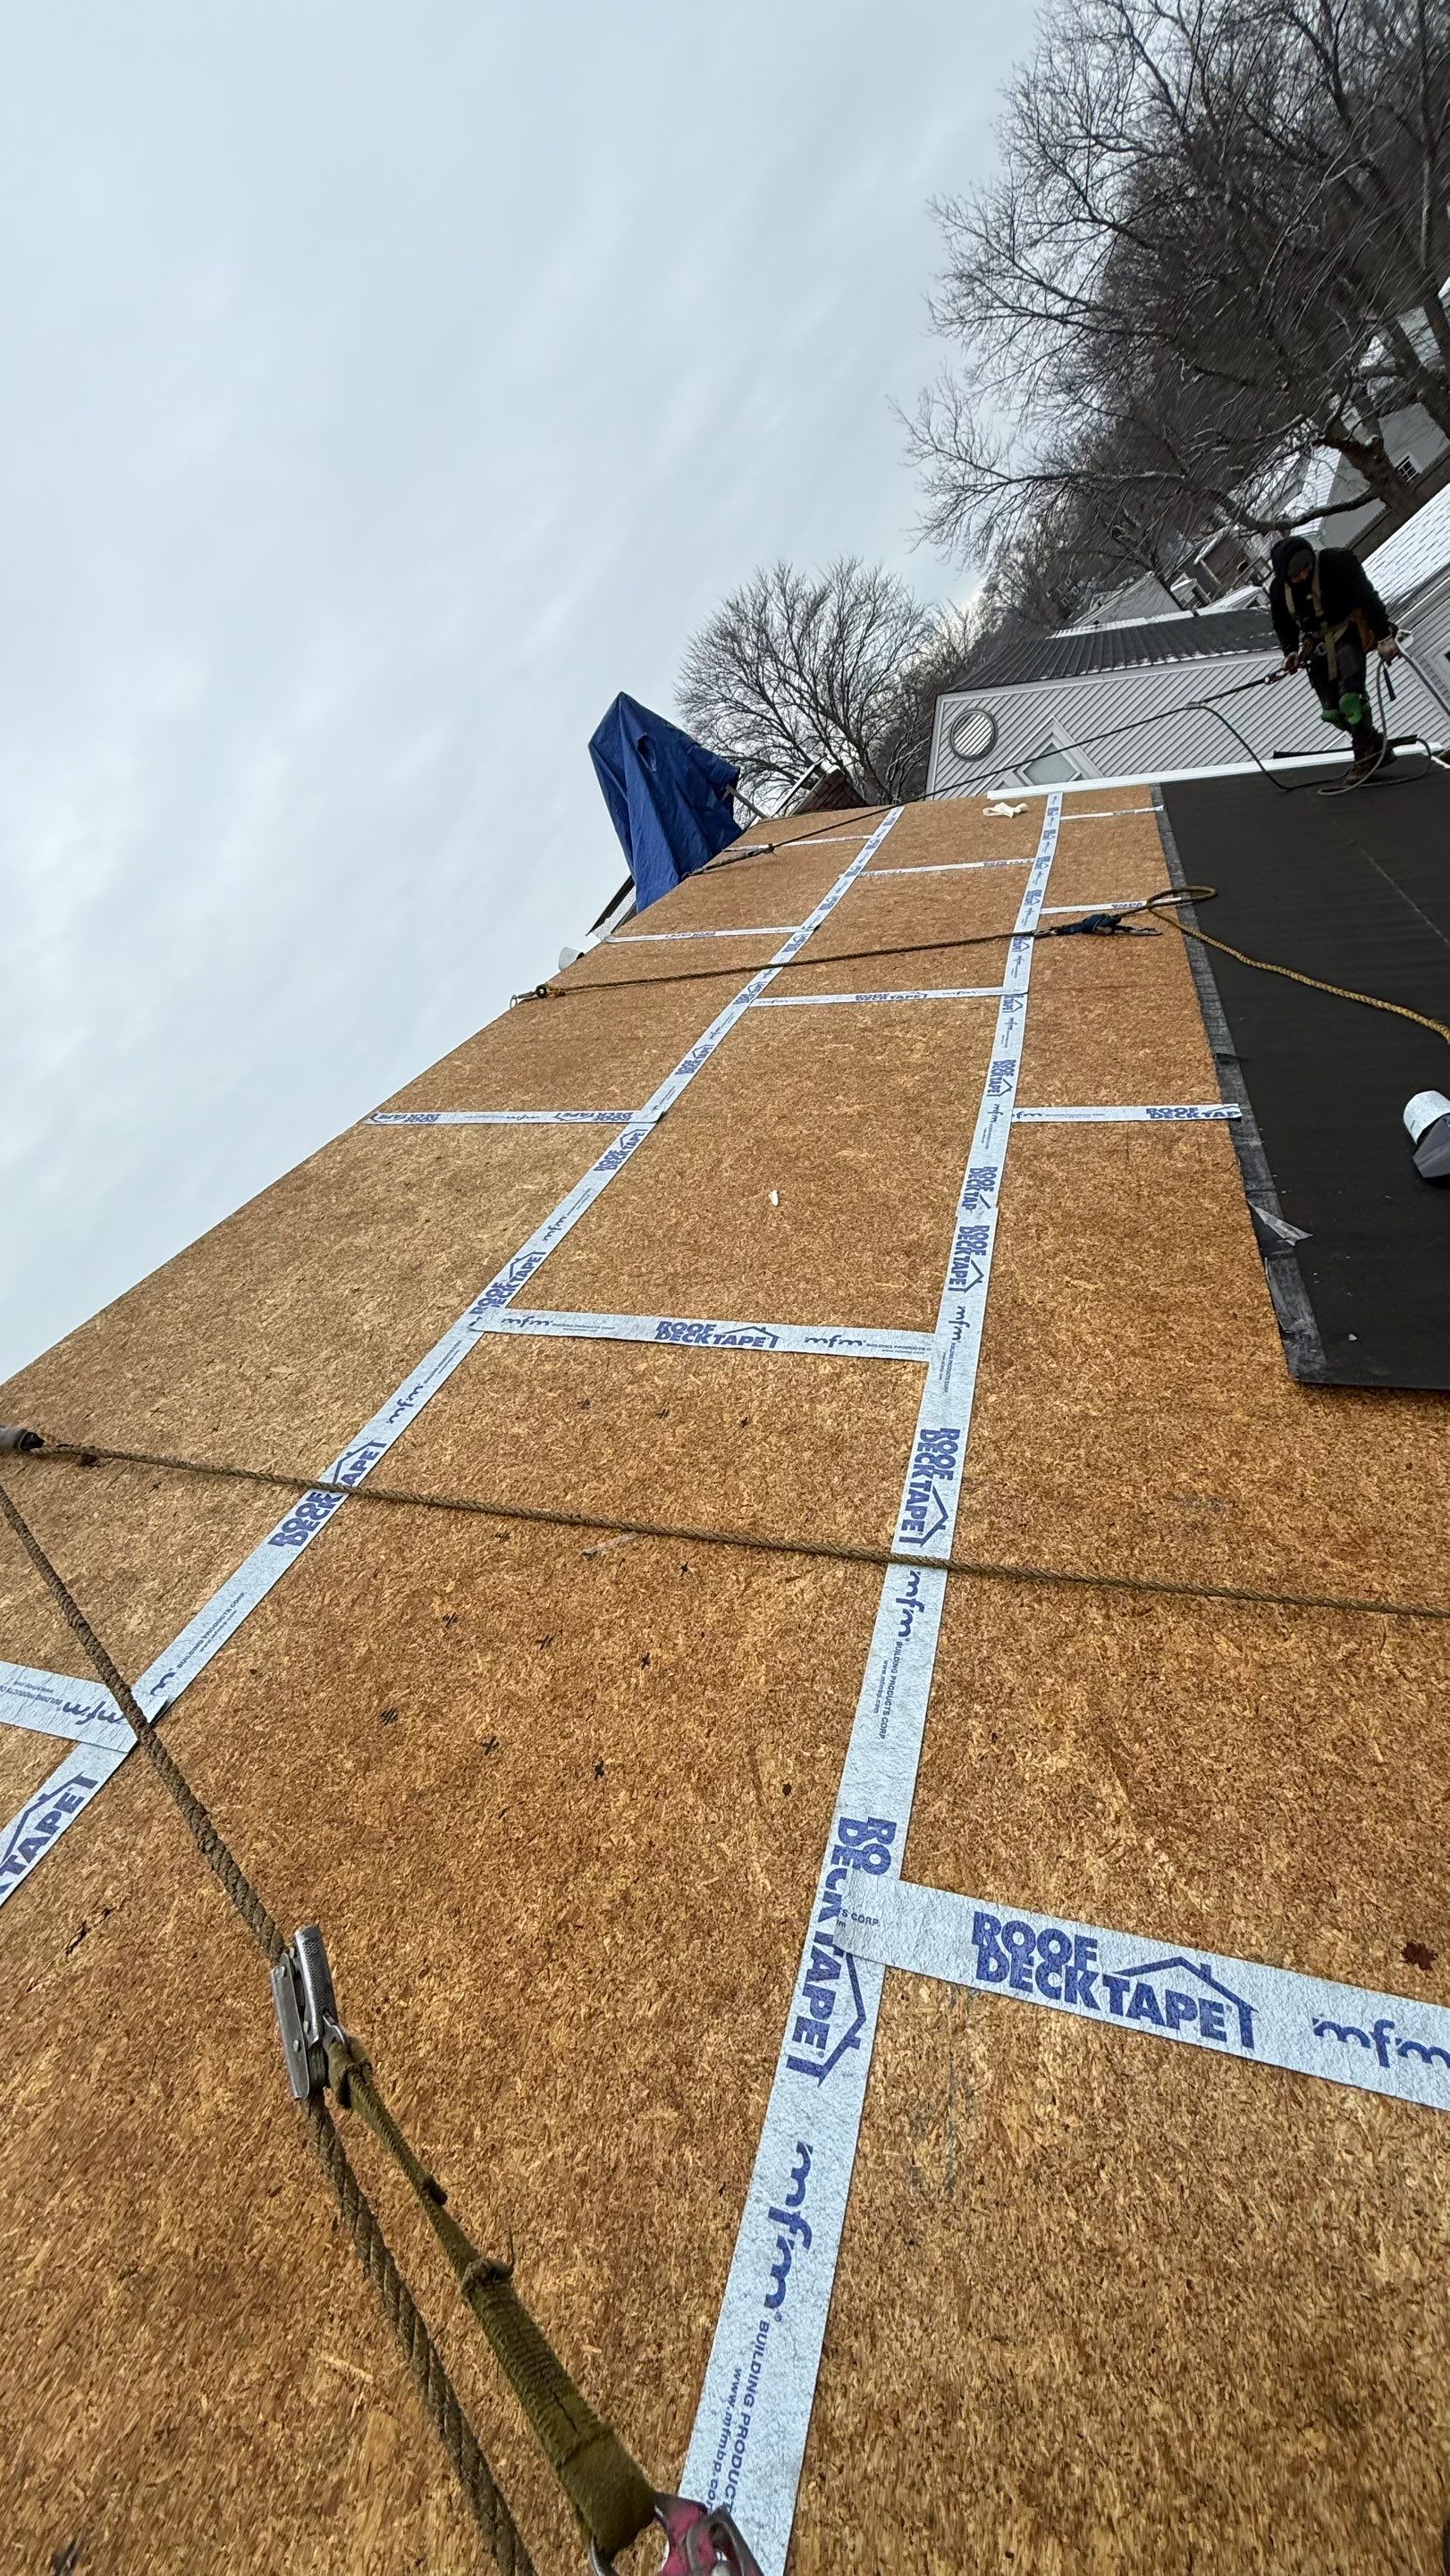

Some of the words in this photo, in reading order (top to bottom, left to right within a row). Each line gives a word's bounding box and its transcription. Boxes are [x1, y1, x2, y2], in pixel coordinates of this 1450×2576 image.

[971, 1225, 990, 1256] ROOF
[491, 1257, 542, 1308] ECKTAPE
[502, 1316, 551, 1327] mfm
[656, 1321, 717, 1334] ROOF
[805, 1334, 863, 1348] mfm
[948, 1306, 970, 1340] mfm
[386, 1385, 424, 1424] mfm
[932, 1428, 961, 1480] ROOF
[901, 1429, 940, 1532] DECKTAPE
[267, 1492, 323, 1547] ROOF
[896, 1570, 924, 1637] mfm
[63, 1701, 125, 1725] mfm
[883, 1675, 897, 1715] PRODUCTS
[972, 1912, 1098, 1970] ROOF
[976, 1946, 1227, 2042] DECKTAPE
[1312, 2017, 1450, 2068] mfm
[763, 2142, 813, 2309] mfm
[744, 2319, 769, 2408] BUILDING
[722, 2414, 751, 2513] PRODUCT
